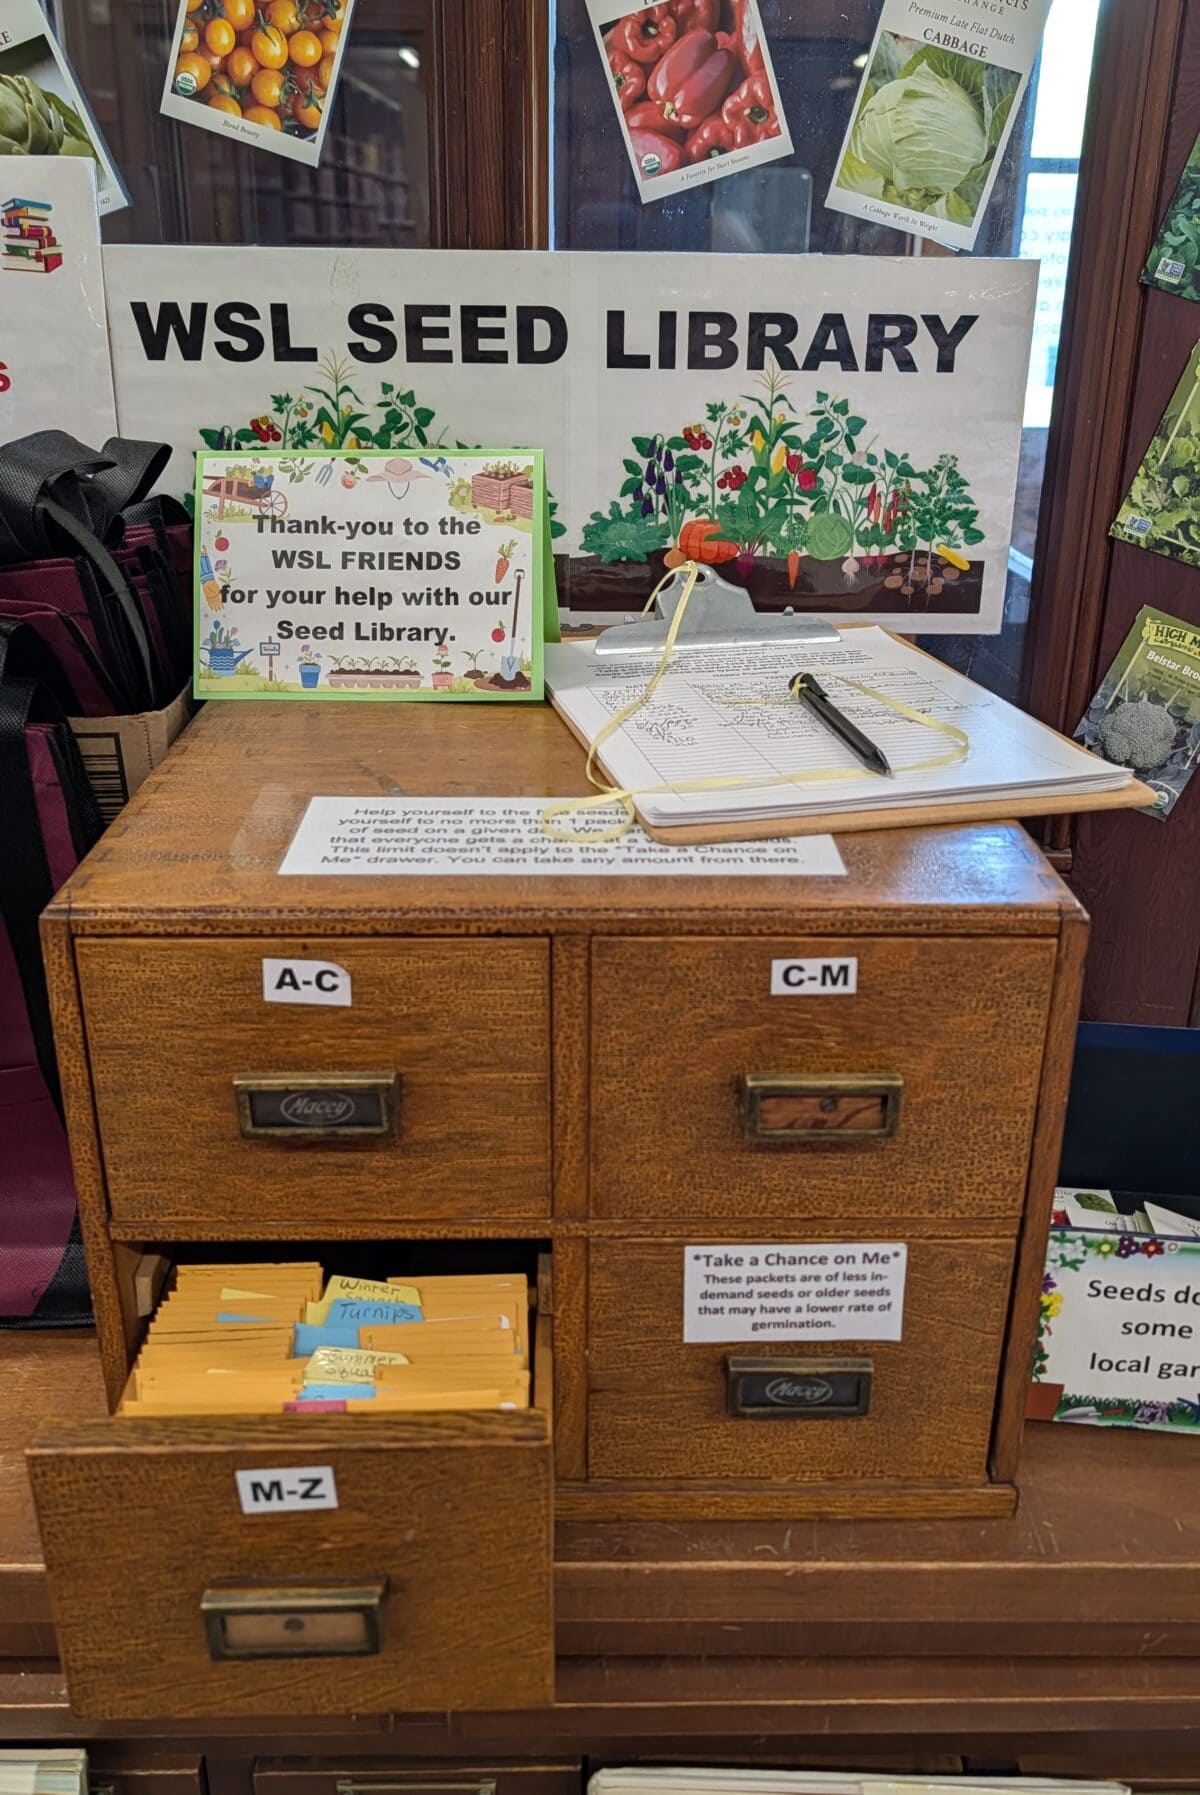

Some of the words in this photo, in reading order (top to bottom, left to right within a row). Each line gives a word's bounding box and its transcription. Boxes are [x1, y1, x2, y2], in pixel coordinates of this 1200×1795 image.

[958, 0, 1005, 15] HANGE
[908, 2, 949, 23] Premium
[950, 15, 969, 30] Late
[970, 22, 988, 35] Flat
[989, 27, 1016, 45] Dutch
[923, 28, 989, 58] CABBAGE
[869, 205, 891, 217] Cabbage
[919, 219, 938, 232] Weight
[130, 301, 318, 362] WSL
[347, 302, 568, 365] SEED
[606, 310, 980, 373] LIBRARY
[252, 514, 393, 540] Thank-you
[403, 517, 429, 536] to
[439, 517, 481, 536] the
[271, 550, 331, 569] WSL
[341, 551, 461, 571] FRIENDS
[219, 584, 258, 604] for
[266, 588, 326, 608] your
[335, 586, 392, 610] help
[402, 587, 459, 606] with
[468, 590, 512, 606] our
[276, 620, 344, 641] Seed
[354, 622, 456, 646] Library.
[1154, 625, 1187, 643] HIGH
[1147, 650, 1181, 671] Belstar
[337, 817, 412, 826] yourself
[354, 809, 396, 817] Help
[402, 808, 475, 817] yourself
[576, 808, 629, 816] seeds
[349, 826, 369, 834] of
[471, 827, 521, 835] given
[331, 846, 370, 854] This
[376, 845, 415, 853] limit
[421, 846, 491, 854] doesn't
[498, 846, 549, 855] apply
[694, 846, 768, 854] Chance
[371, 837, 459, 845] everyone
[465, 836, 505, 845] gets
[366, 856, 440, 864] drawer.
[533, 856, 574, 864] take
[581, 857, 615, 865] any
[621, 856, 694, 864] amount
[749, 856, 805, 864] there.
[275, 967, 339, 992] A-C
[782, 965, 850, 988] C-M
[749, 1256, 759, 1266] a
[764, 1252, 828, 1266] Chance
[833, 1254, 856, 1265] on
[340, 1279, 401, 1295] Winter
[704, 1274, 742, 1284] These
[746, 1273, 796, 1285] packets
[800, 1274, 821, 1282] are
[825, 1272, 839, 1282] of
[842, 1272, 867, 1281] less
[870, 1271, 888, 1281] in-
[700, 1288, 753, 1300] demand
[757, 1288, 794, 1298] seeds
[797, 1290, 812, 1298] or
[815, 1287, 850, 1298] older
[853, 1286, 891, 1297] seeds
[1087, 1279, 1166, 1303] Seeds
[340, 1302, 415, 1323] Turnips
[698, 1305, 725, 1315] that
[728, 1306, 756, 1316] may
[760, 1304, 791, 1313] have
[795, 1305, 802, 1313] a
[806, 1303, 844, 1313] lower
[848, 1303, 874, 1312] rate
[878, 1301, 893, 1312] of
[751, 1319, 836, 1332] germination.
[1120, 1321, 1193, 1339] some
[1089, 1352, 1151, 1374] local
[1157, 1362, 1200, 1380] gar
[250, 1477, 326, 1502] M-Z
